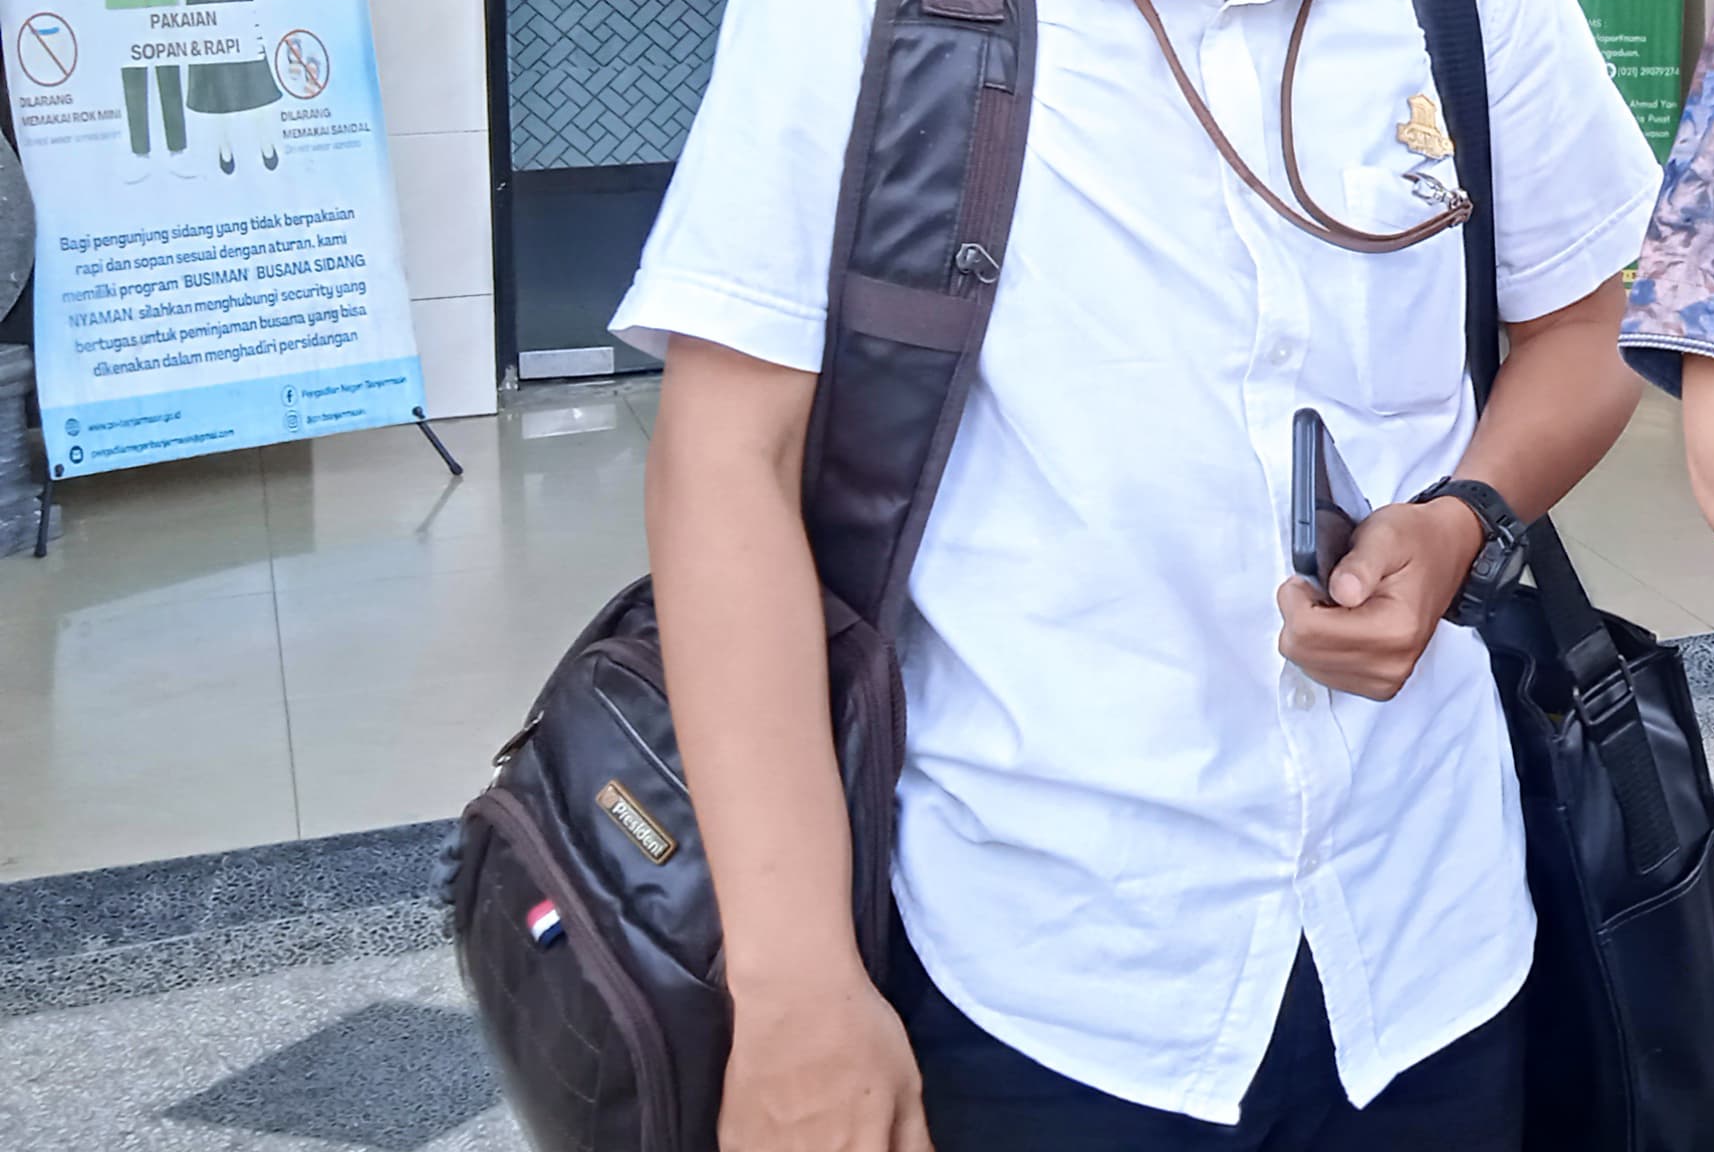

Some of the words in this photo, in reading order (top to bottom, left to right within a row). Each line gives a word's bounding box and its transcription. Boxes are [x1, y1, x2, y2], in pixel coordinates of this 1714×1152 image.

[150, 11, 217, 29] PAKAIAN
[131, 42, 188, 60] SOPAN
[190, 40, 201, 56] &
[203, 38, 241, 55] RAPI
[280, 108, 332, 122] DILARANG
[331, 123, 371, 136] SANDAL
[59, 234, 91, 253] Bagi
[93, 228, 169, 251] pengunjung
[171, 224, 213, 239] sidang
[216, 220, 248, 238] yang
[250, 214, 282, 230] tidak
[284, 208, 355, 227] berpakaian
[75, 259, 103, 277] rapi
[106, 258, 131, 272] dan
[134, 254, 174, 271] sopan
[176, 246, 216, 263] sesuai
[219, 243, 266, 260] dengan
[317, 233, 347, 248] kami
[119, 279, 178, 299] program
[256, 258, 312, 280] BUSANA
[314, 254, 366, 273] SIDANG
[69, 307, 133, 328] NYAMAN
[138, 302, 192, 320] silahkan
[194, 289, 278, 313] menghubungi
[281, 283, 333, 302] security
[335, 281, 366, 298] yang
[75, 335, 138, 353] bertugas
[140, 328, 177, 345] untuk
[179, 319, 257, 342] peminjaman
[259, 314, 306, 330] busana
[307, 310, 339, 327] yang
[340, 304, 367, 318] bisa
[93, 357, 161, 377] dikenakan
[162, 351, 203, 368] dalam
[205, 338, 277, 363] menghadiri
[279, 330, 358, 355] persidangan
[611, 798, 669, 857] President
